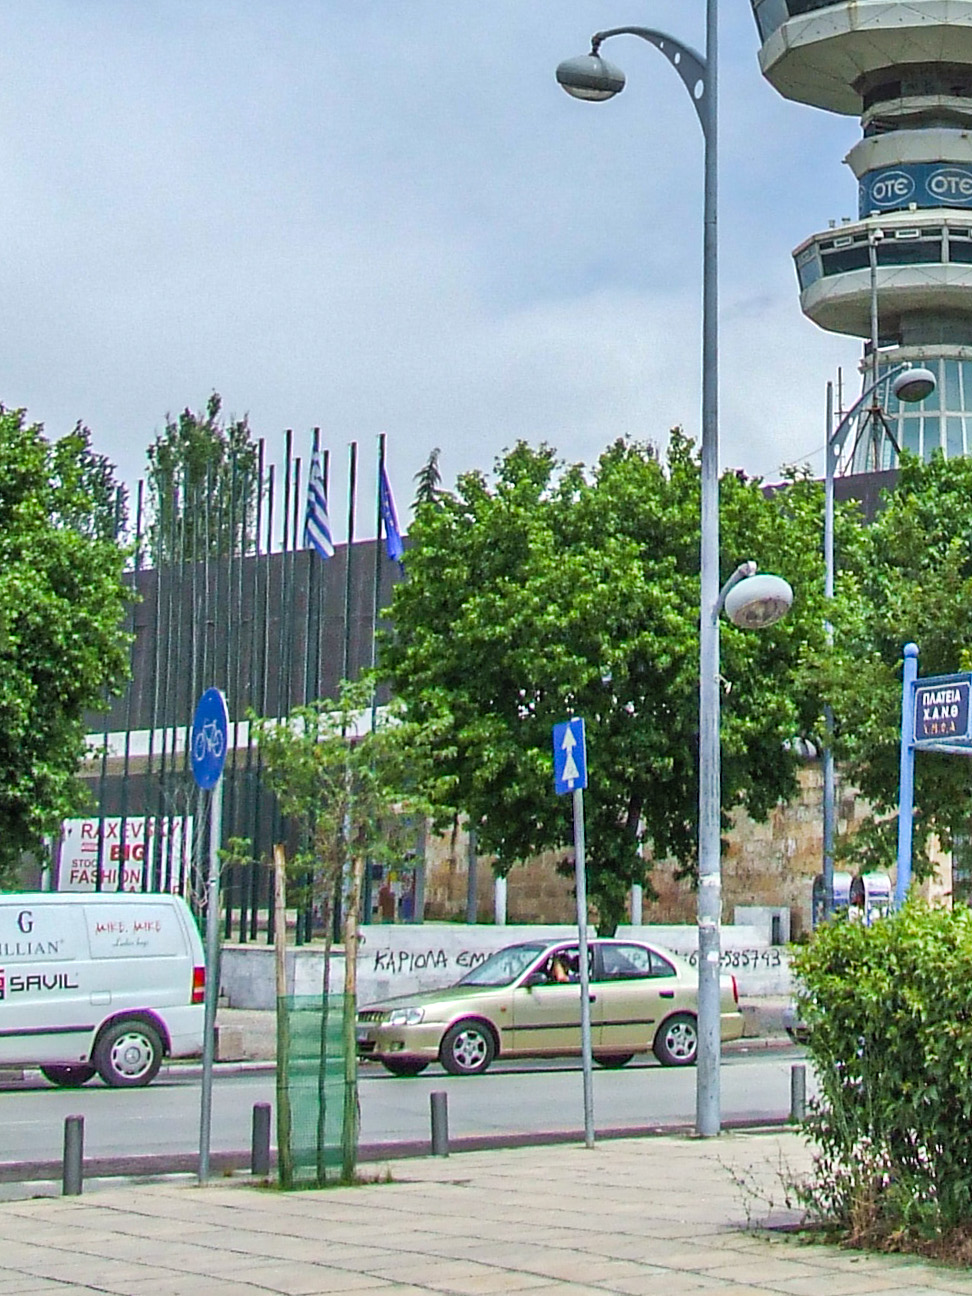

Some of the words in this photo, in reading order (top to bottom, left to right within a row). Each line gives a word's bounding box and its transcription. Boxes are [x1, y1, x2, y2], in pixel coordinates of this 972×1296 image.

[923, 689, 961, 706] ΠΛΑΤΕΙΑ
[110, 844, 145, 861] BIG
[70, 869, 141, 884] FASHION
[17, 910, 34, 934] G
[10, 973, 79, 992] SAVIL
